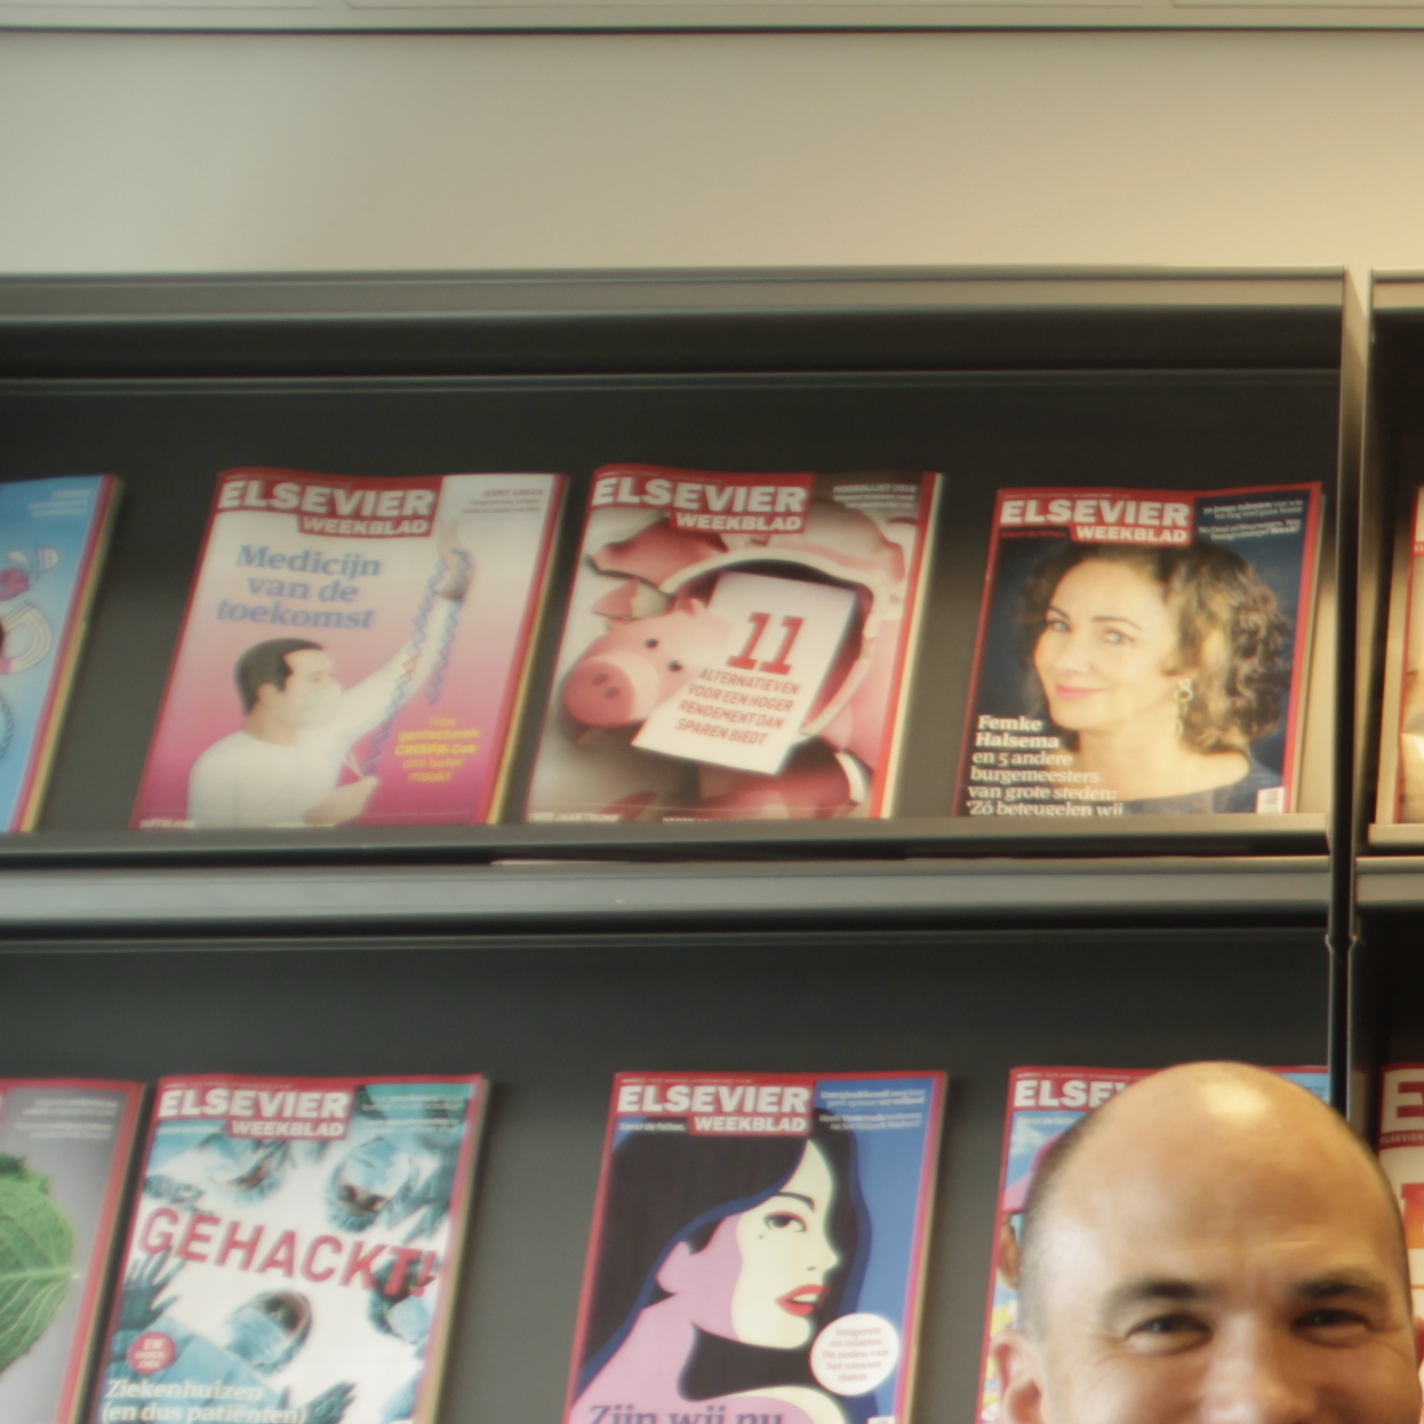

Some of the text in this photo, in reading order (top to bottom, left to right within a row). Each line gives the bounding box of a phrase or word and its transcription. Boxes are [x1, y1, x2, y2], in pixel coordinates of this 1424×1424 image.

[217, 480, 434, 517] ELSEVIER
[591, 477, 807, 513] ELSEVIER
[303, 516, 428, 535] WEEKBLAD
[676, 512, 802, 532] WEEKBLAD
[1000, 499, 1190, 527] ELSEVIER
[1076, 525, 1188, 542] WEEKBLAD
[236, 544, 381, 580] Medicijn
[248, 576, 358, 602] van de
[216, 599, 373, 629] toekomst
[726, 611, 805, 675] 11
[978, 714, 1042, 732] Femke
[975, 732, 1059, 749] Halsema
[158, 1088, 349, 1118] ELSEVIER
[617, 1086, 811, 1114] ELSEVIER
[232, 1120, 345, 1136] WEEKBLAD
[693, 1116, 807, 1133] WEEKBLAD
[140, 1207, 439, 1297] GEHACKT!
